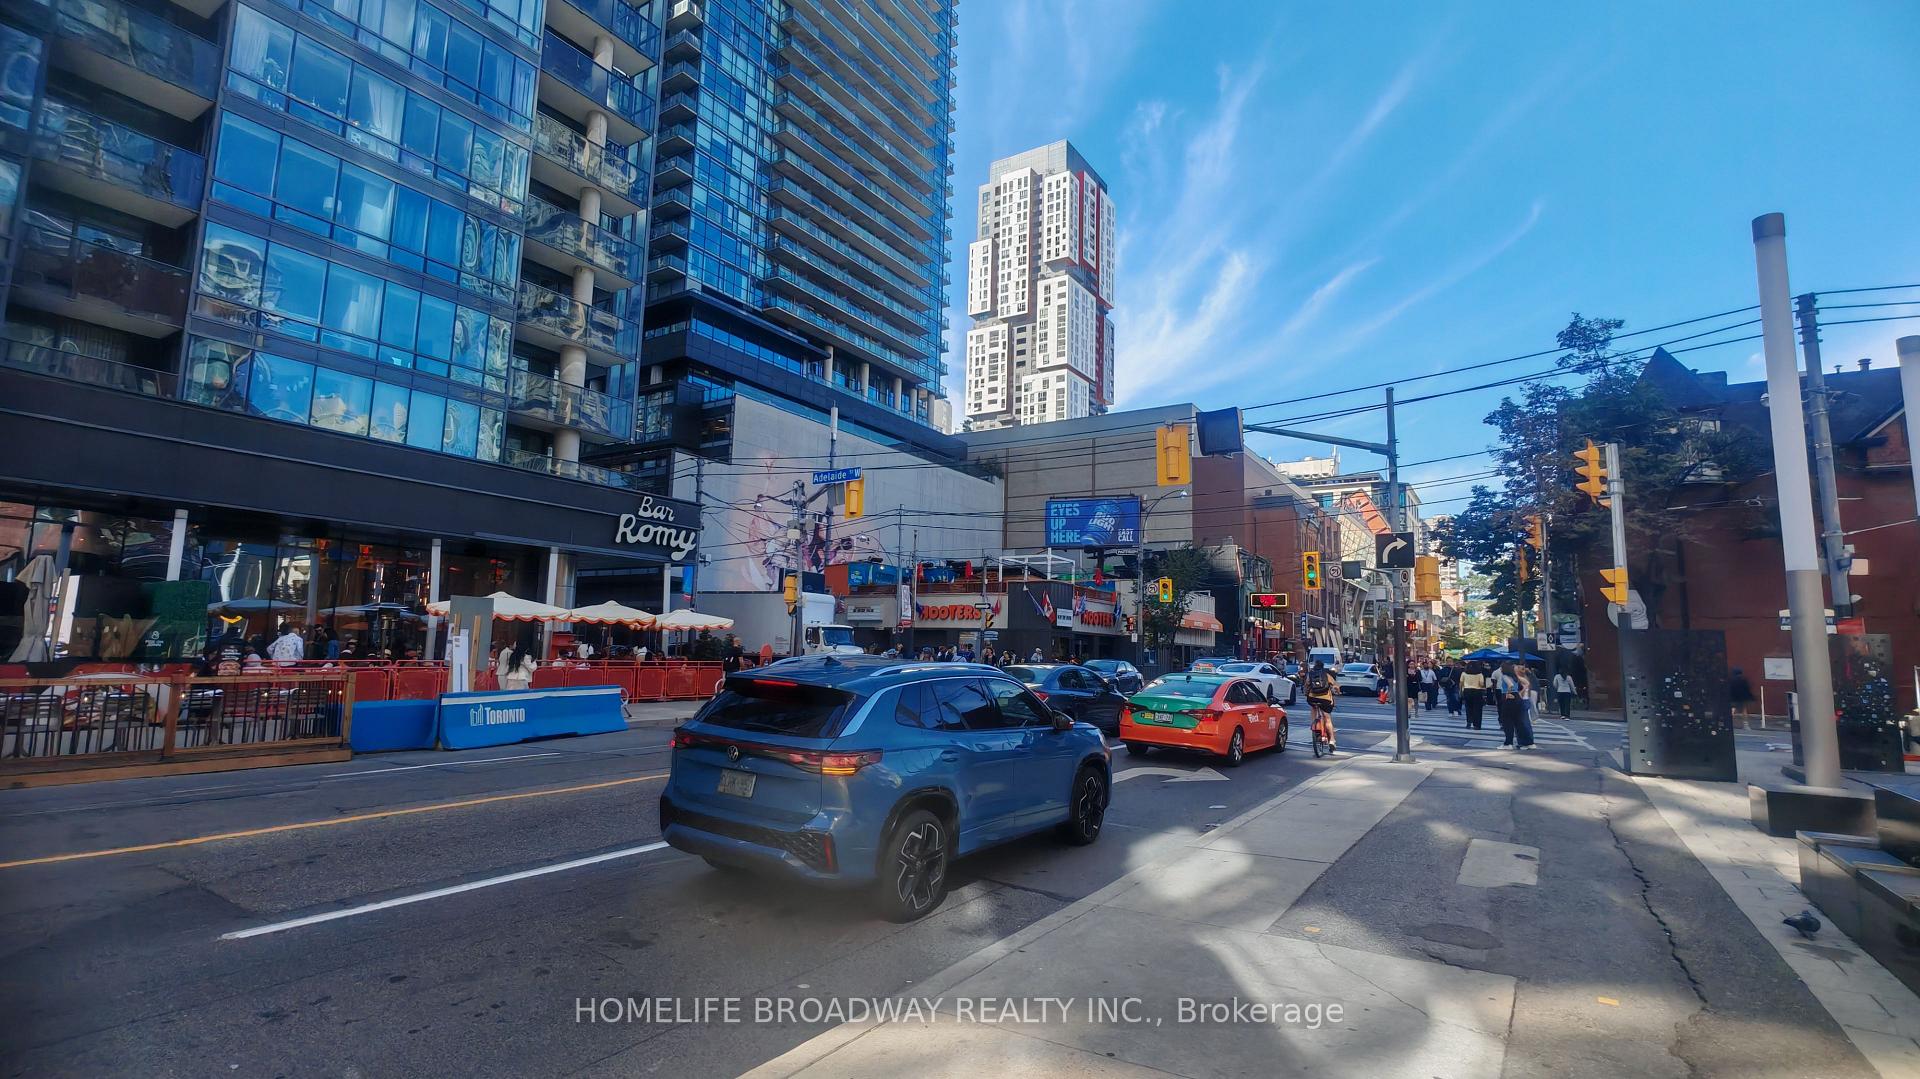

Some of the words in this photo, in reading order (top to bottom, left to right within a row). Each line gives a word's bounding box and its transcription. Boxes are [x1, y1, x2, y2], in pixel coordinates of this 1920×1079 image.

[813, 472, 847, 483] Adelaide
[854, 468, 861, 478] W
[638, 496, 675, 522] Bar
[1050, 503, 1080, 516] EYES
[1050, 517, 1067, 530] UP
[615, 513, 696, 561] Romy
[1050, 530, 1081, 543] HERE
[1118, 534, 1134, 542] CALL
[920, 604, 982, 620] HOOTERS
[485, 707, 526, 725] TORONTO
